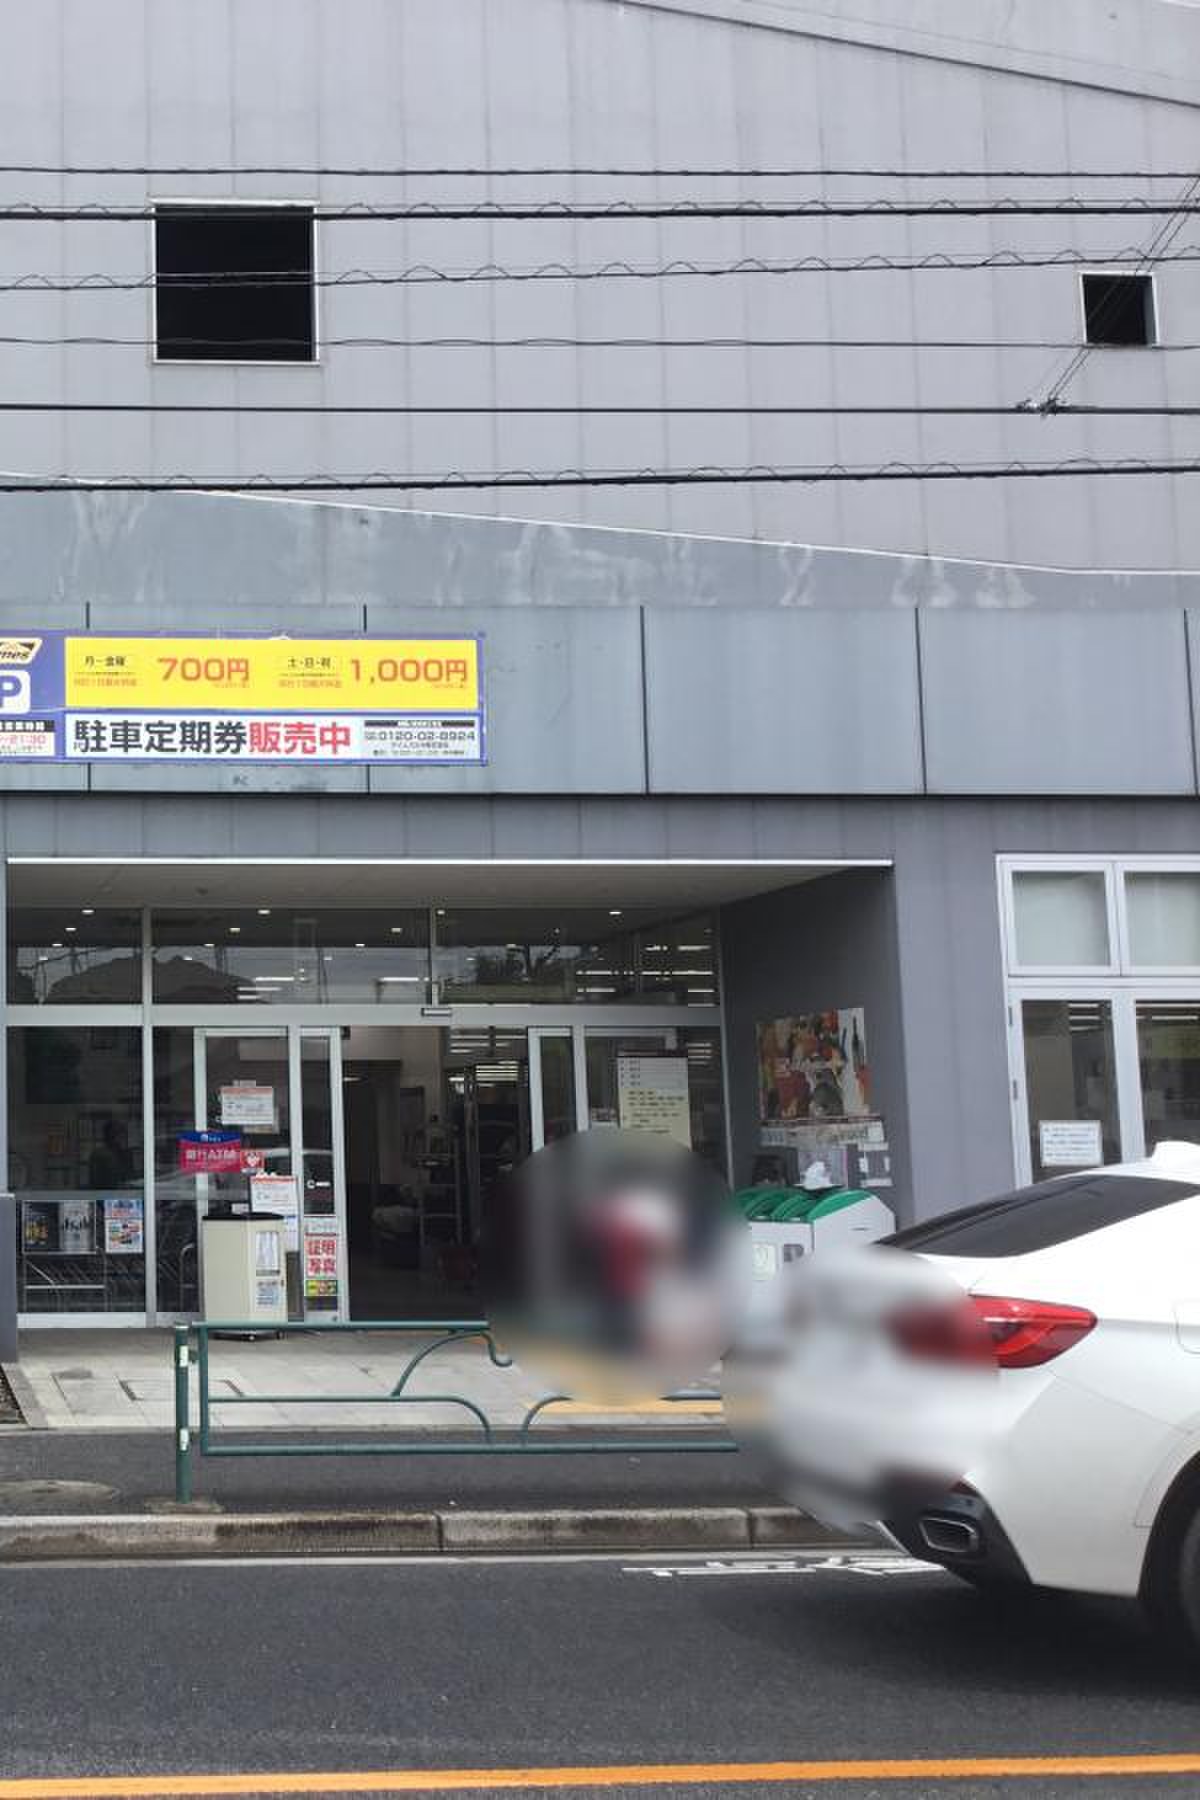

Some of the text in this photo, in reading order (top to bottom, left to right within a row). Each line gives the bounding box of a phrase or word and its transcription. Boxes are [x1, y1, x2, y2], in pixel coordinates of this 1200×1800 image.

[157, 658, 250, 681] 700円
[351, 658, 468, 684] 1,000円
[73, 720, 352, 754] 駐車定期券販売中
